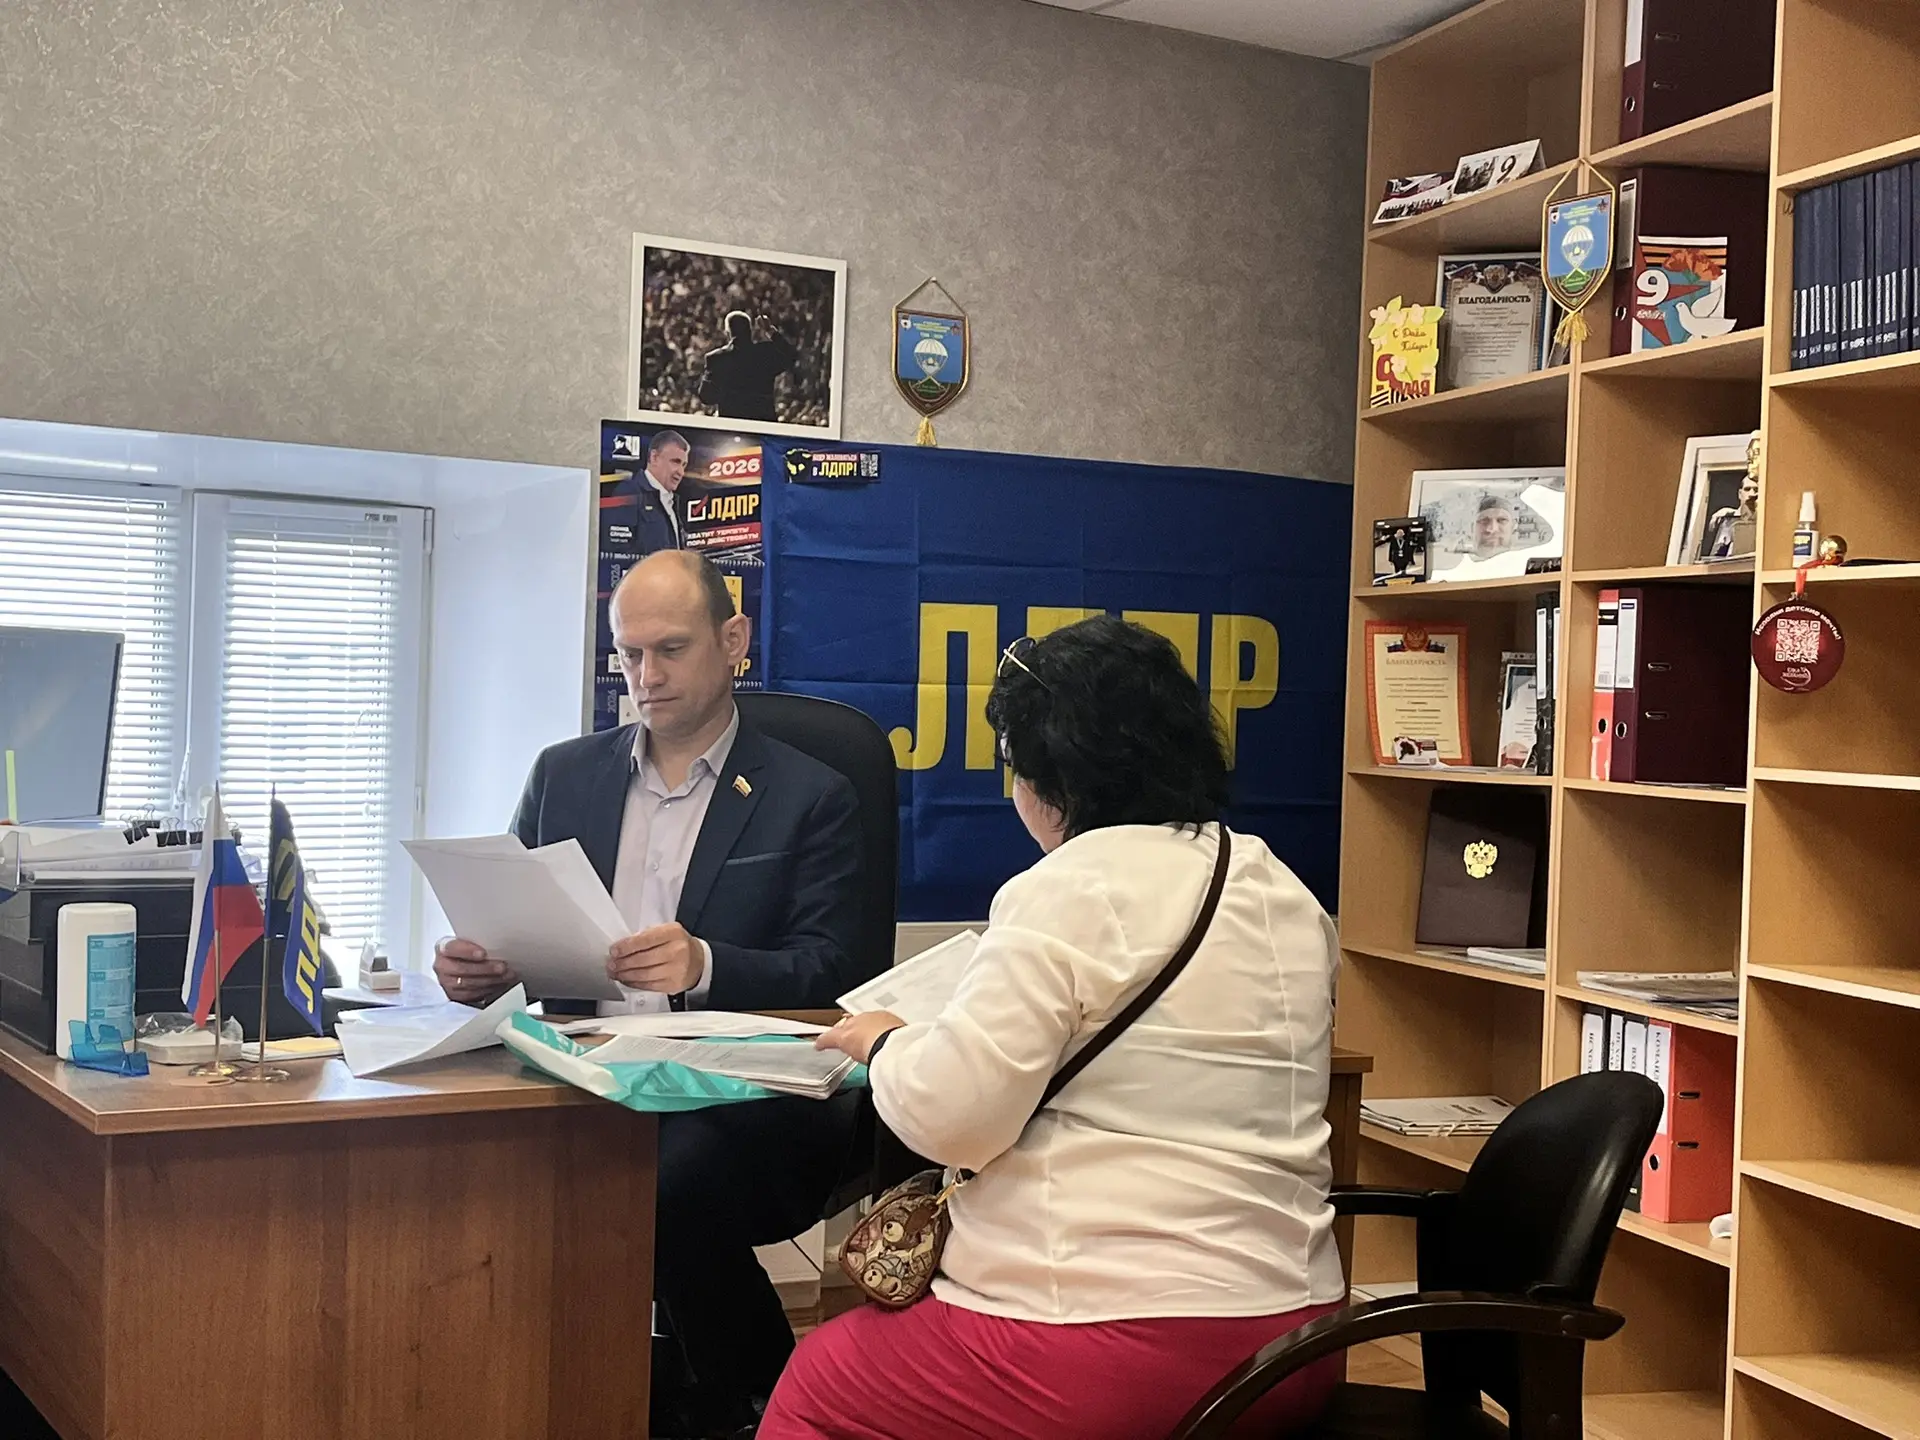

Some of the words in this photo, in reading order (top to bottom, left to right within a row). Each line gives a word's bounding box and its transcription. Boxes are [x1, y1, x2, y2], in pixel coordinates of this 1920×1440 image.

[1636, 269, 1670, 306] 9
[1458, 295, 1532, 305] БЛАГОДАРНОСТЬ
[709, 458, 760, 478] 2026
[819, 461, 858, 478] ЛДПР!
[707, 493, 760, 521] ЛДПР
[888, 602, 1280, 798] ЛР
